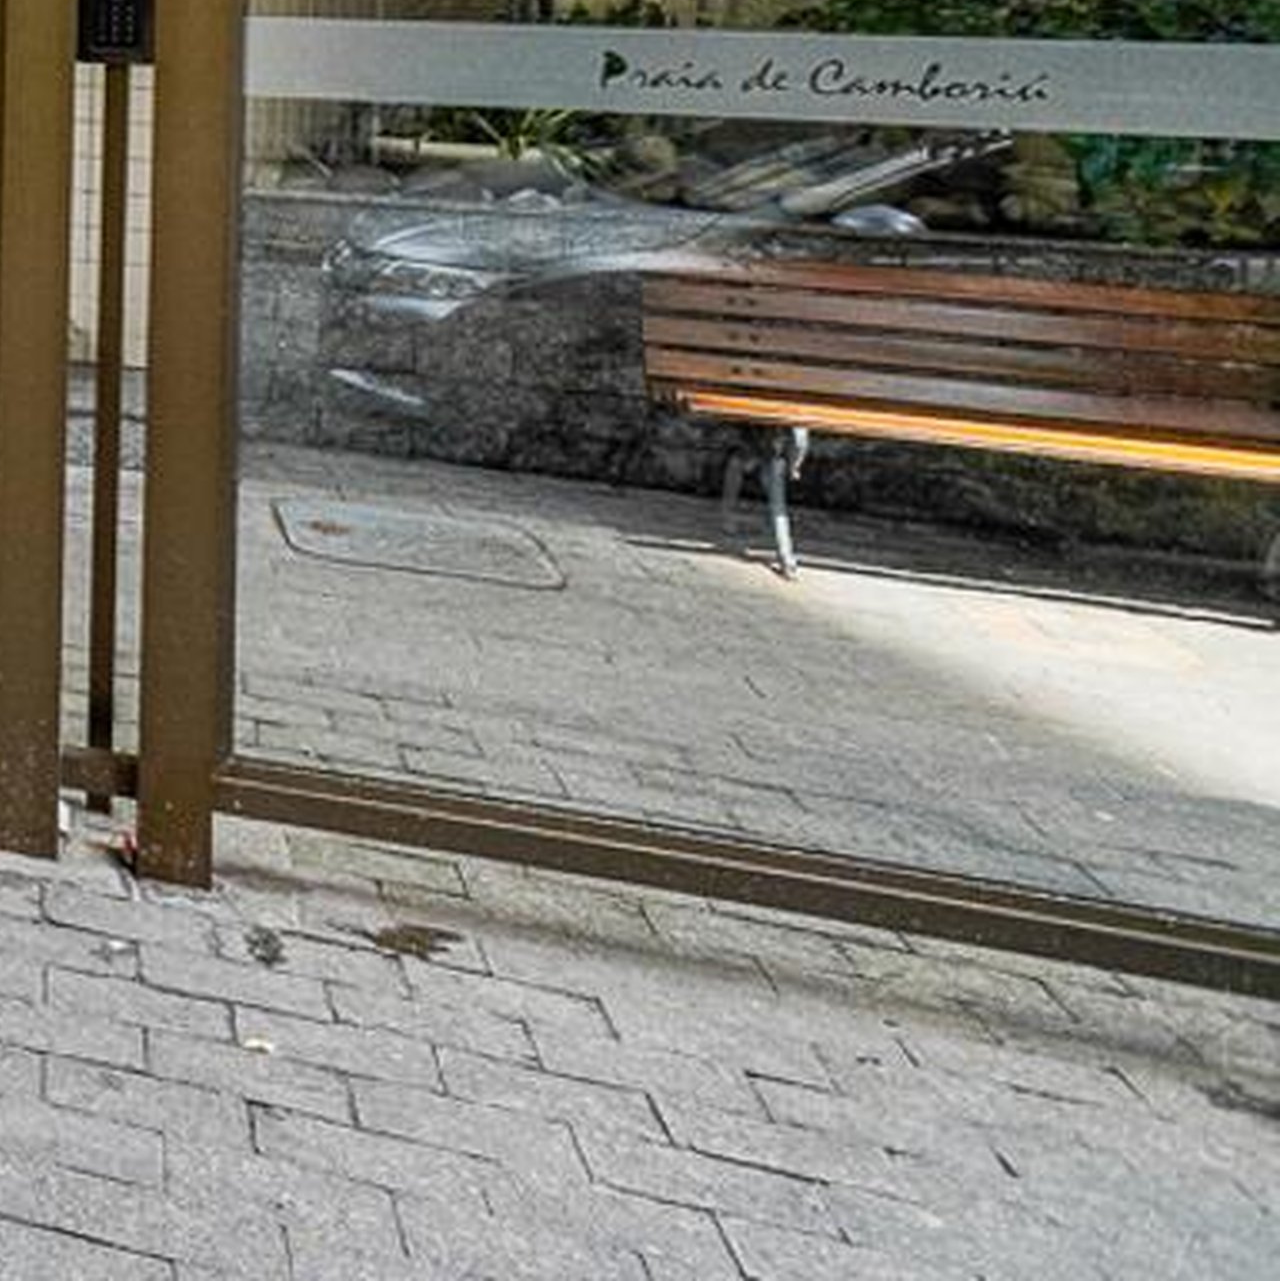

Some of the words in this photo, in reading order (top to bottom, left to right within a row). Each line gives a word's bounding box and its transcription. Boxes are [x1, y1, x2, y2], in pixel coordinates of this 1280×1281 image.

[599, 50, 722, 90] Praia
[741, 58, 788, 93] de
[809, 58, 1049, 101] Camboriú
